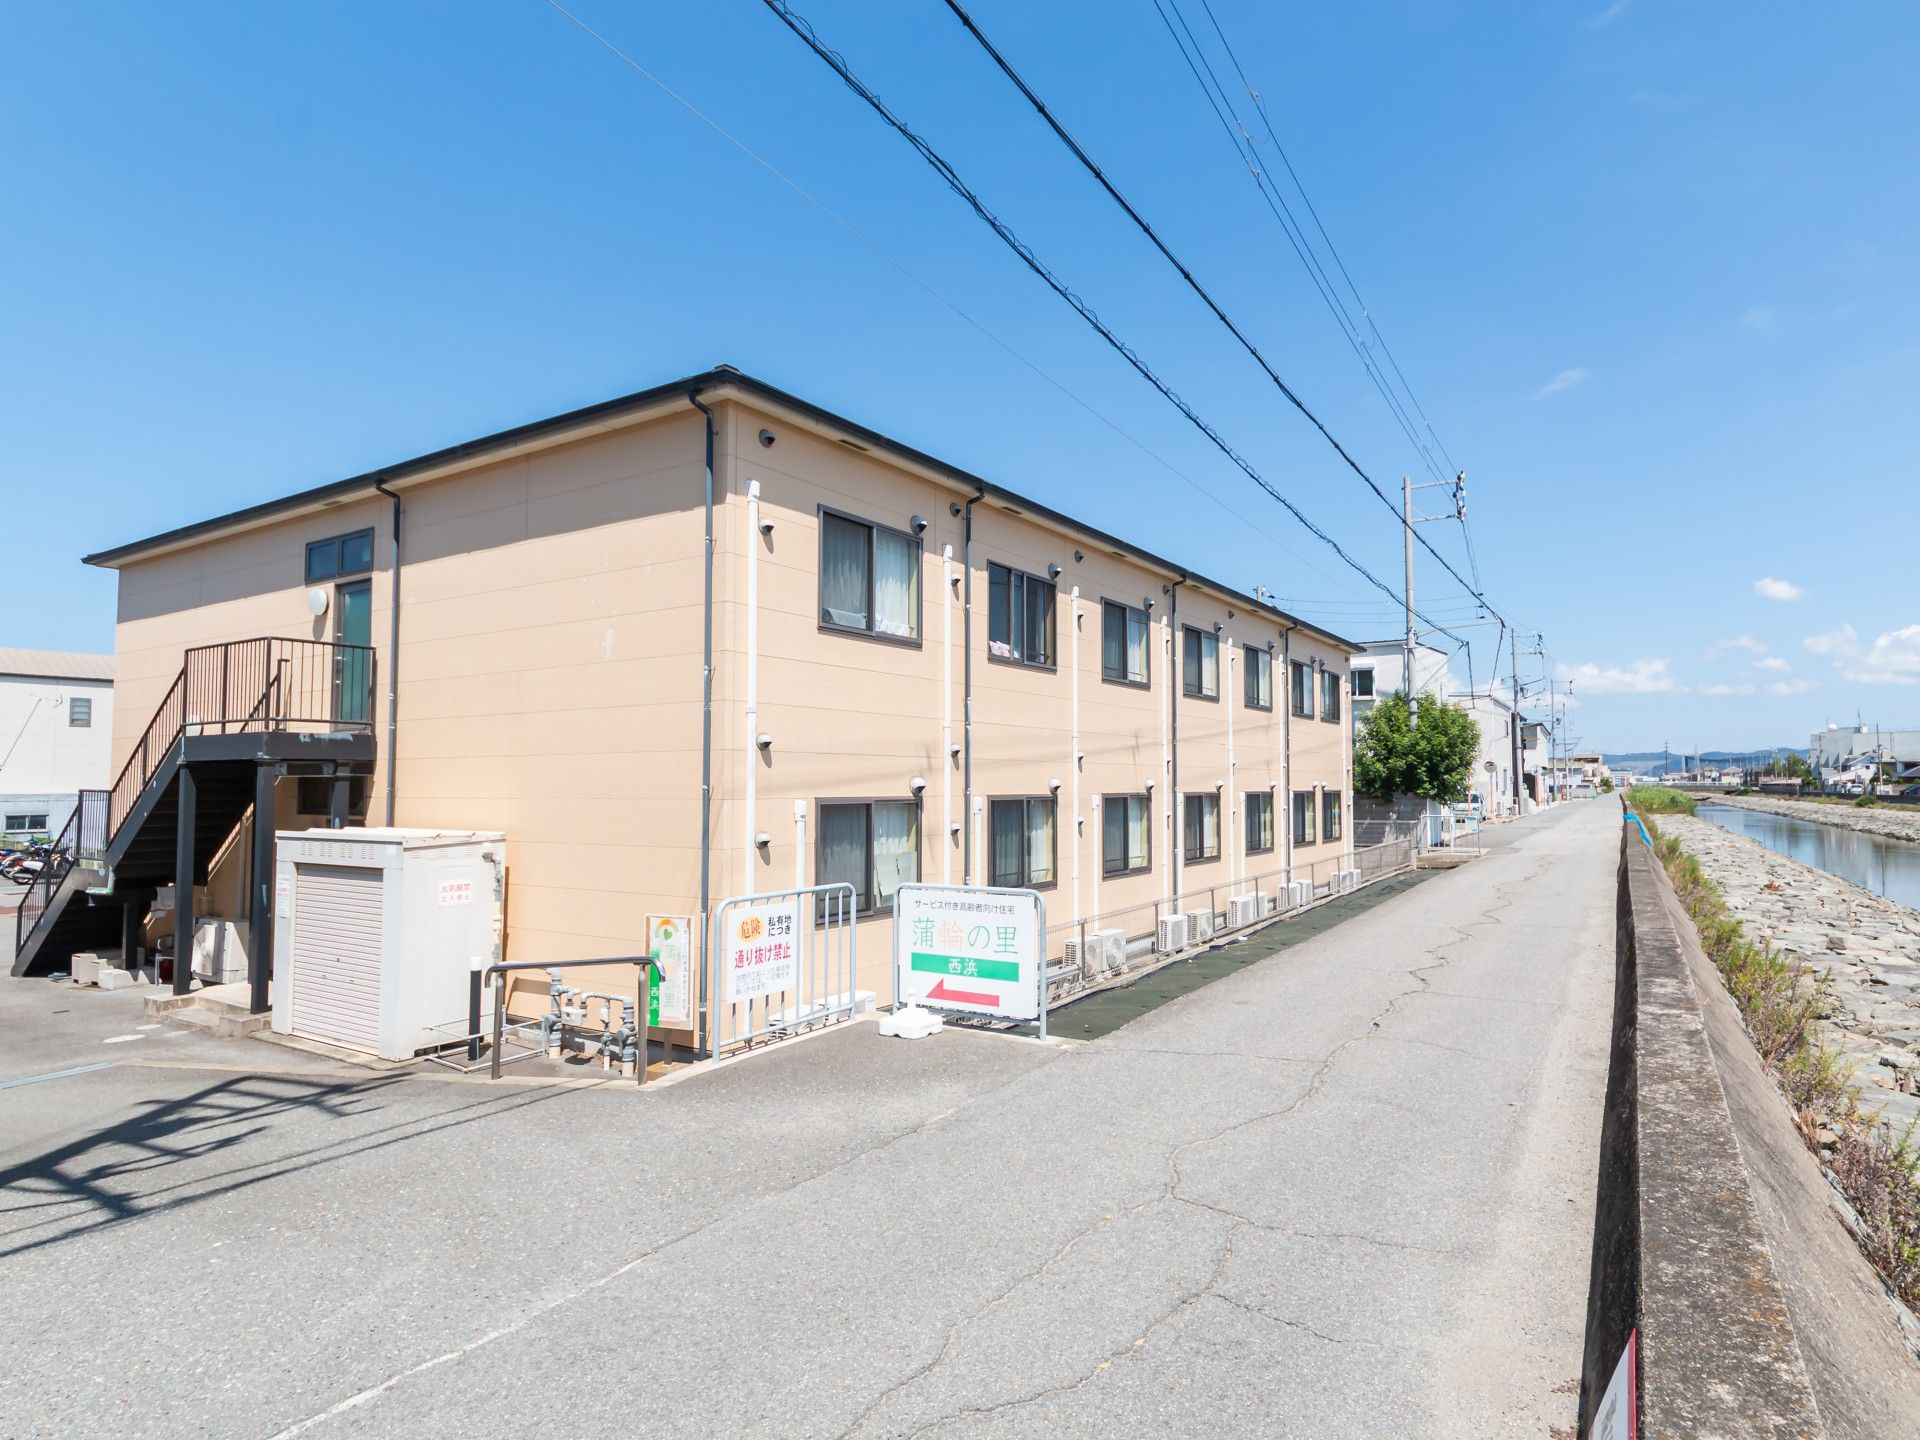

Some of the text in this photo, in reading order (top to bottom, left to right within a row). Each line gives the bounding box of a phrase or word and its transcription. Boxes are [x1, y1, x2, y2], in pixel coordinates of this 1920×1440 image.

[915, 900, 1015, 915] サービス付き高齢者向け住宅
[741, 917, 761, 940] 危険
[768, 914, 792, 927] 私有地
[768, 925, 791, 937] につき
[913, 917, 1019, 954] 蒲輪の里
[735, 941, 792, 969] 通り抜け禁止
[949, 958, 978, 977] 西浜
